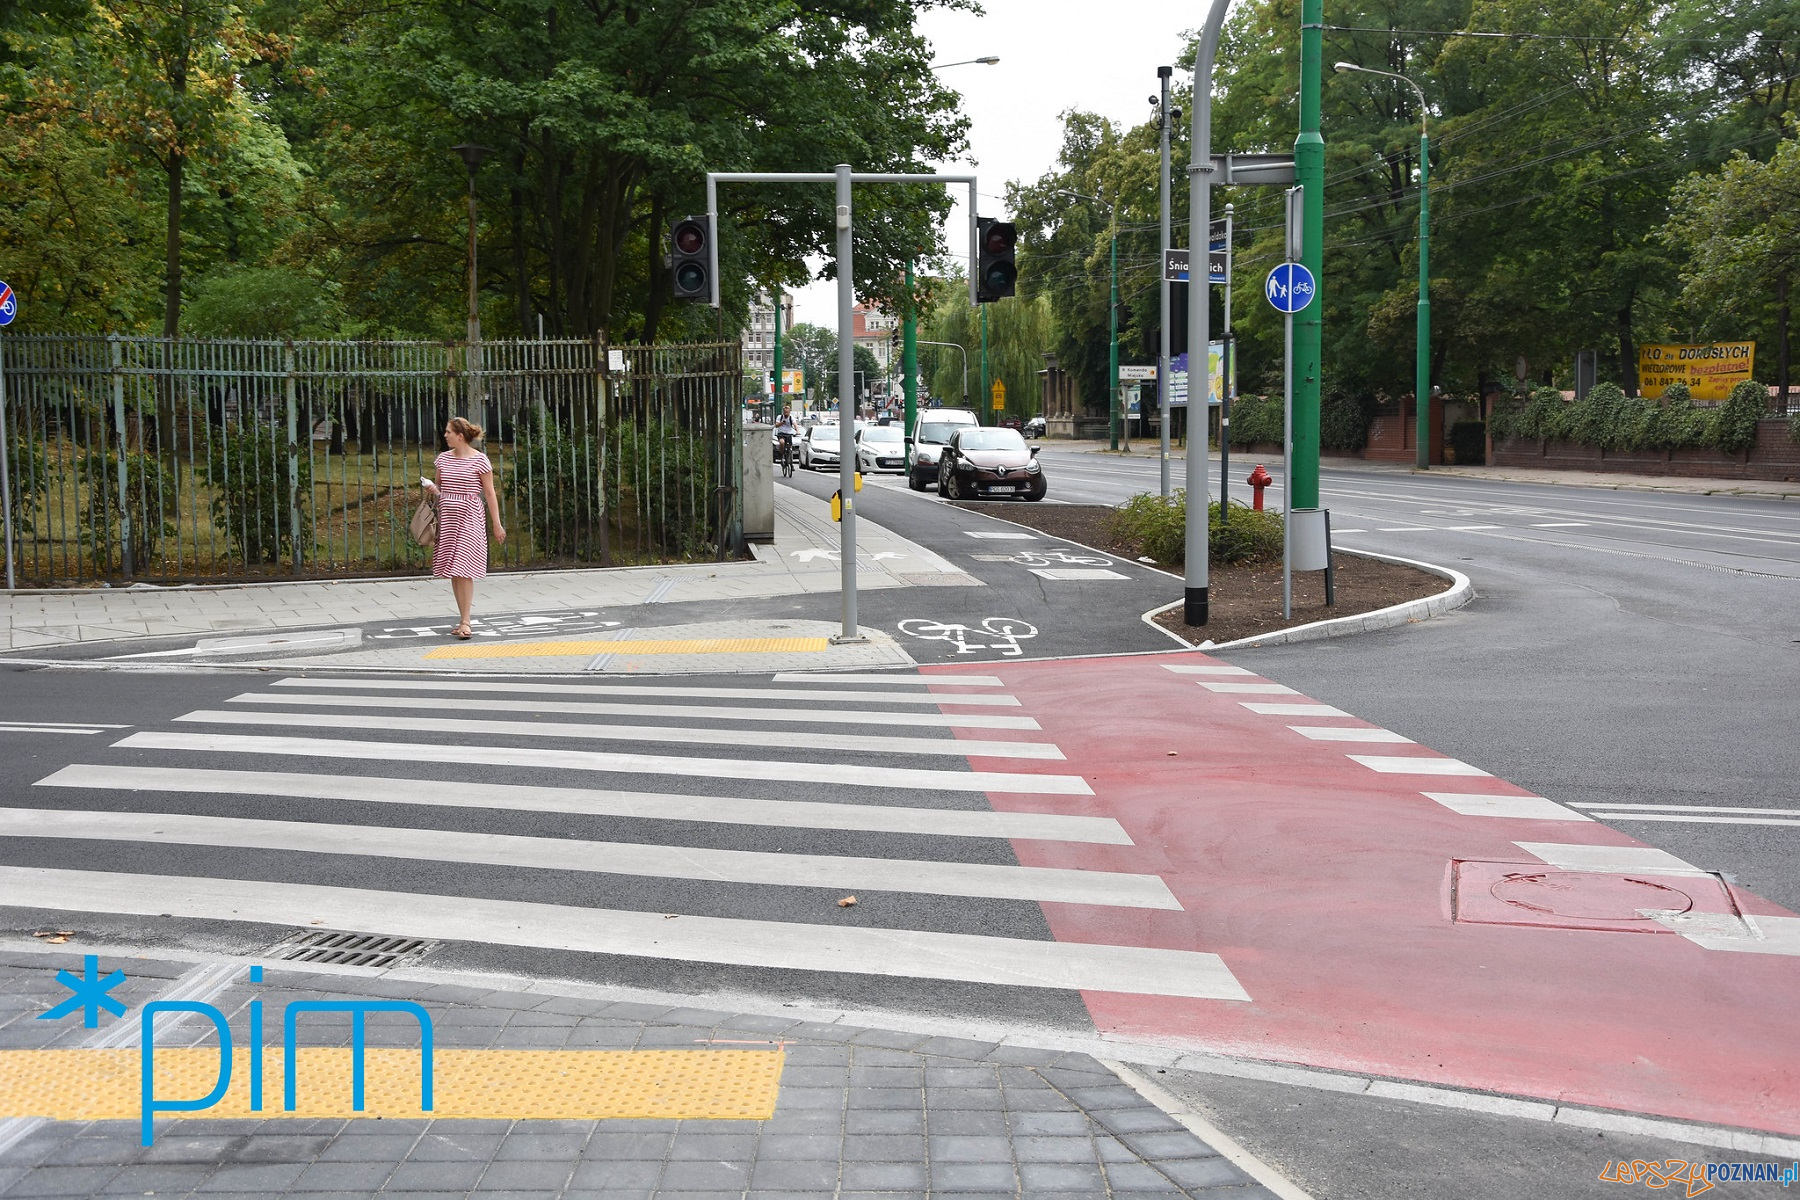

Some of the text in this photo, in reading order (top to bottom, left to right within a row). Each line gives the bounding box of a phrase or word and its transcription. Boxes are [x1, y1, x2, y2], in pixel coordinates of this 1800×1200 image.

[1168, 258, 1223, 273] Śniaich
[1642, 363, 1686, 374] WIECZOROWE
[1644, 377, 1657, 386] 061
[1659, 377, 1674, 387] 847
[1690, 377, 1701, 387] 34
